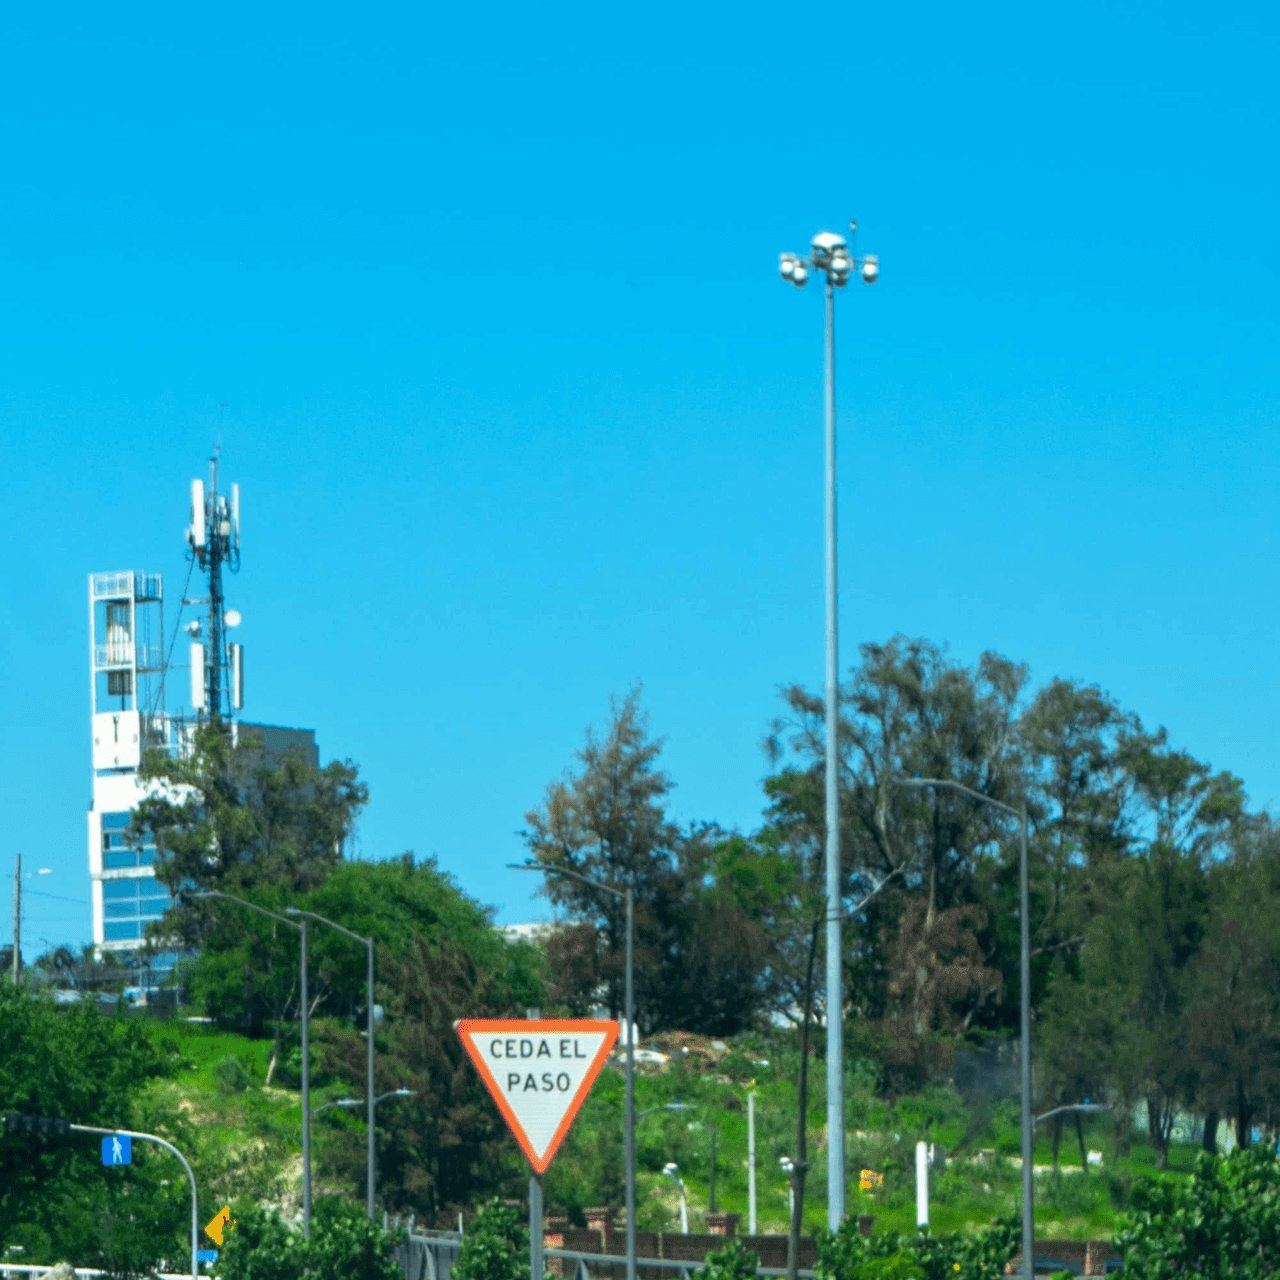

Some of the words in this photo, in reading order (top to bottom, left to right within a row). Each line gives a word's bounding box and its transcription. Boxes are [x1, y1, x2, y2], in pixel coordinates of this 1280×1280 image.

[490, 1038, 551, 1058] CEDA
[560, 1038, 587, 1058] EL
[507, 1072, 570, 1092] PASO
